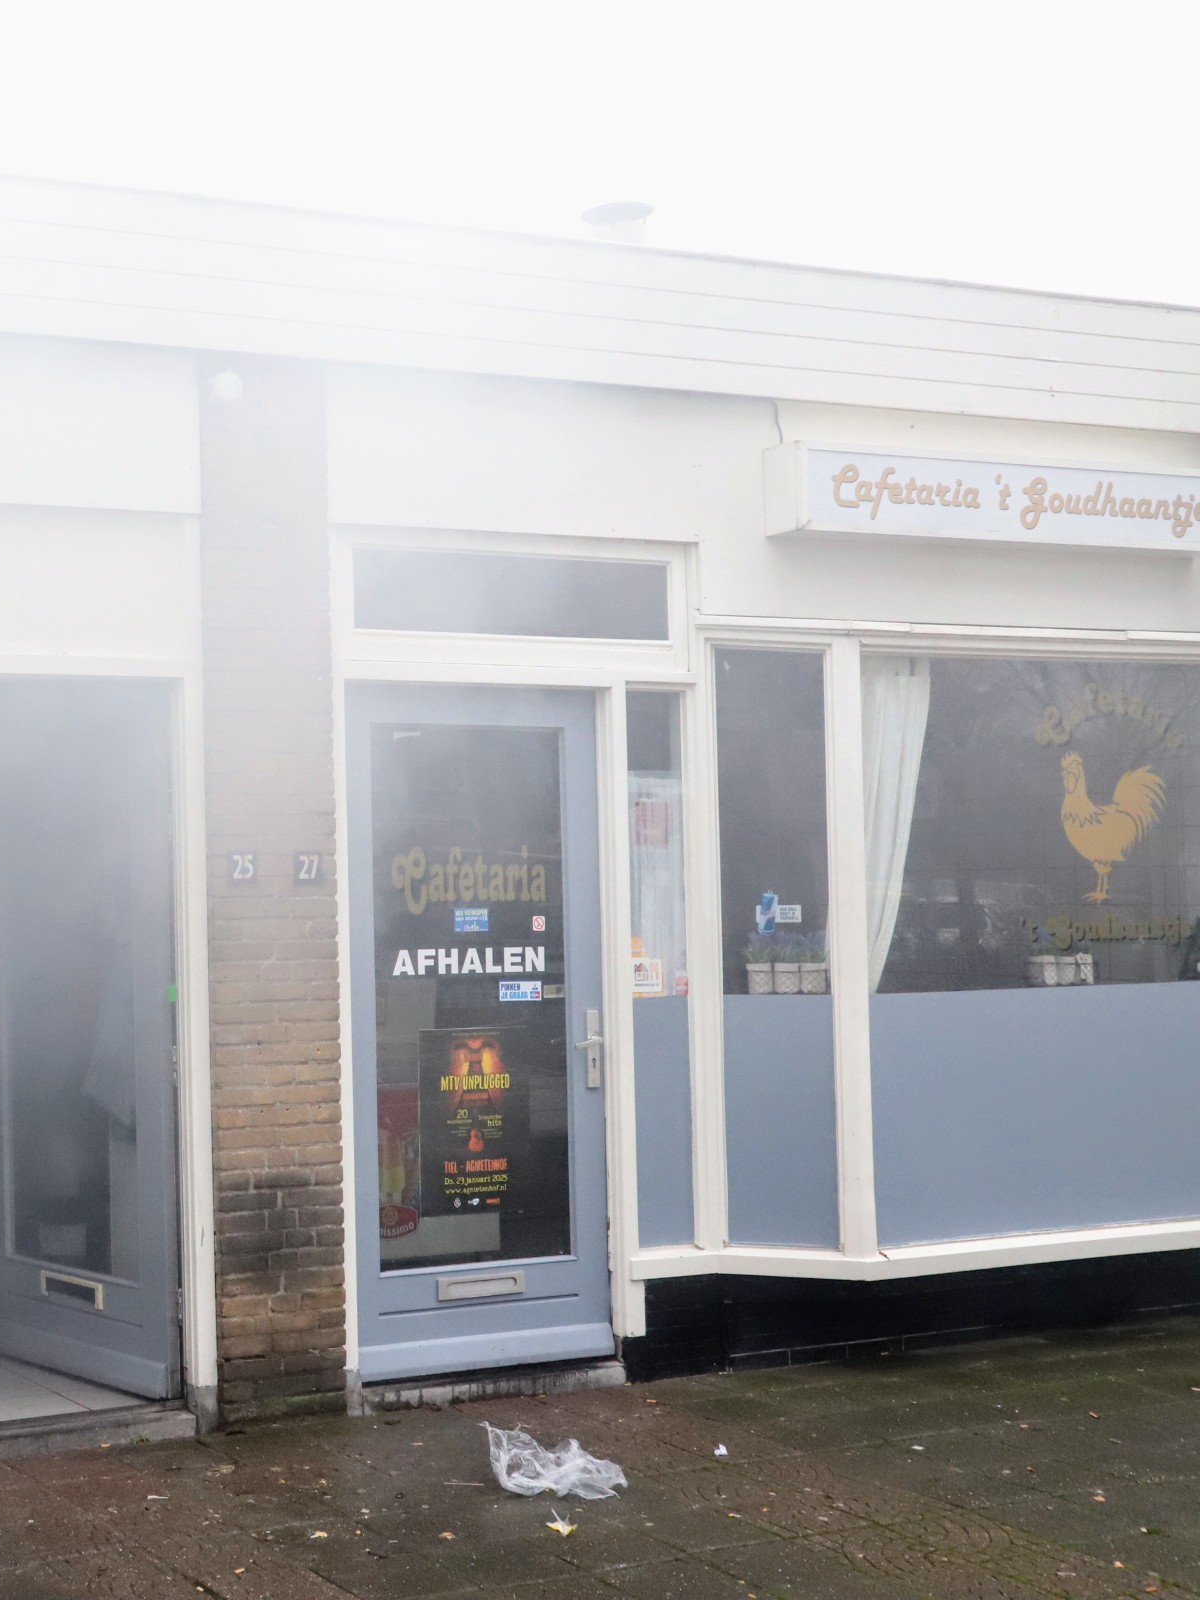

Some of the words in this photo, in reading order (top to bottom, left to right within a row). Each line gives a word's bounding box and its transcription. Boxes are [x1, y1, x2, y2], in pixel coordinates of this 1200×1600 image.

[832, 463, 981, 521] Cafetaria
[995, 474, 1012, 510] 't
[232, 854, 254, 880] 25
[299, 854, 318, 880] 27
[391, 844, 547, 915] Cafetaria
[393, 946, 545, 976] AFHALEN
[501, 983, 521, 991] PINNEN
[501, 991, 508, 999] JA
[509, 991, 528, 999] GRAAG
[441, 1075, 460, 1091] MTV
[463, 1074, 510, 1090] UNPLUGGED
[457, 1109, 469, 1119] 20
[487, 1119, 502, 1127] hits
[444, 1161, 458, 1174] TIEL
[466, 1158, 508, 1173] AGNIETENHOF
[444, 1177, 454, 1185] Do.
[456, 1177, 465, 1185] 23
[465, 1175, 491, 1186] januari
[492, 1174, 508, 1182] 2025
